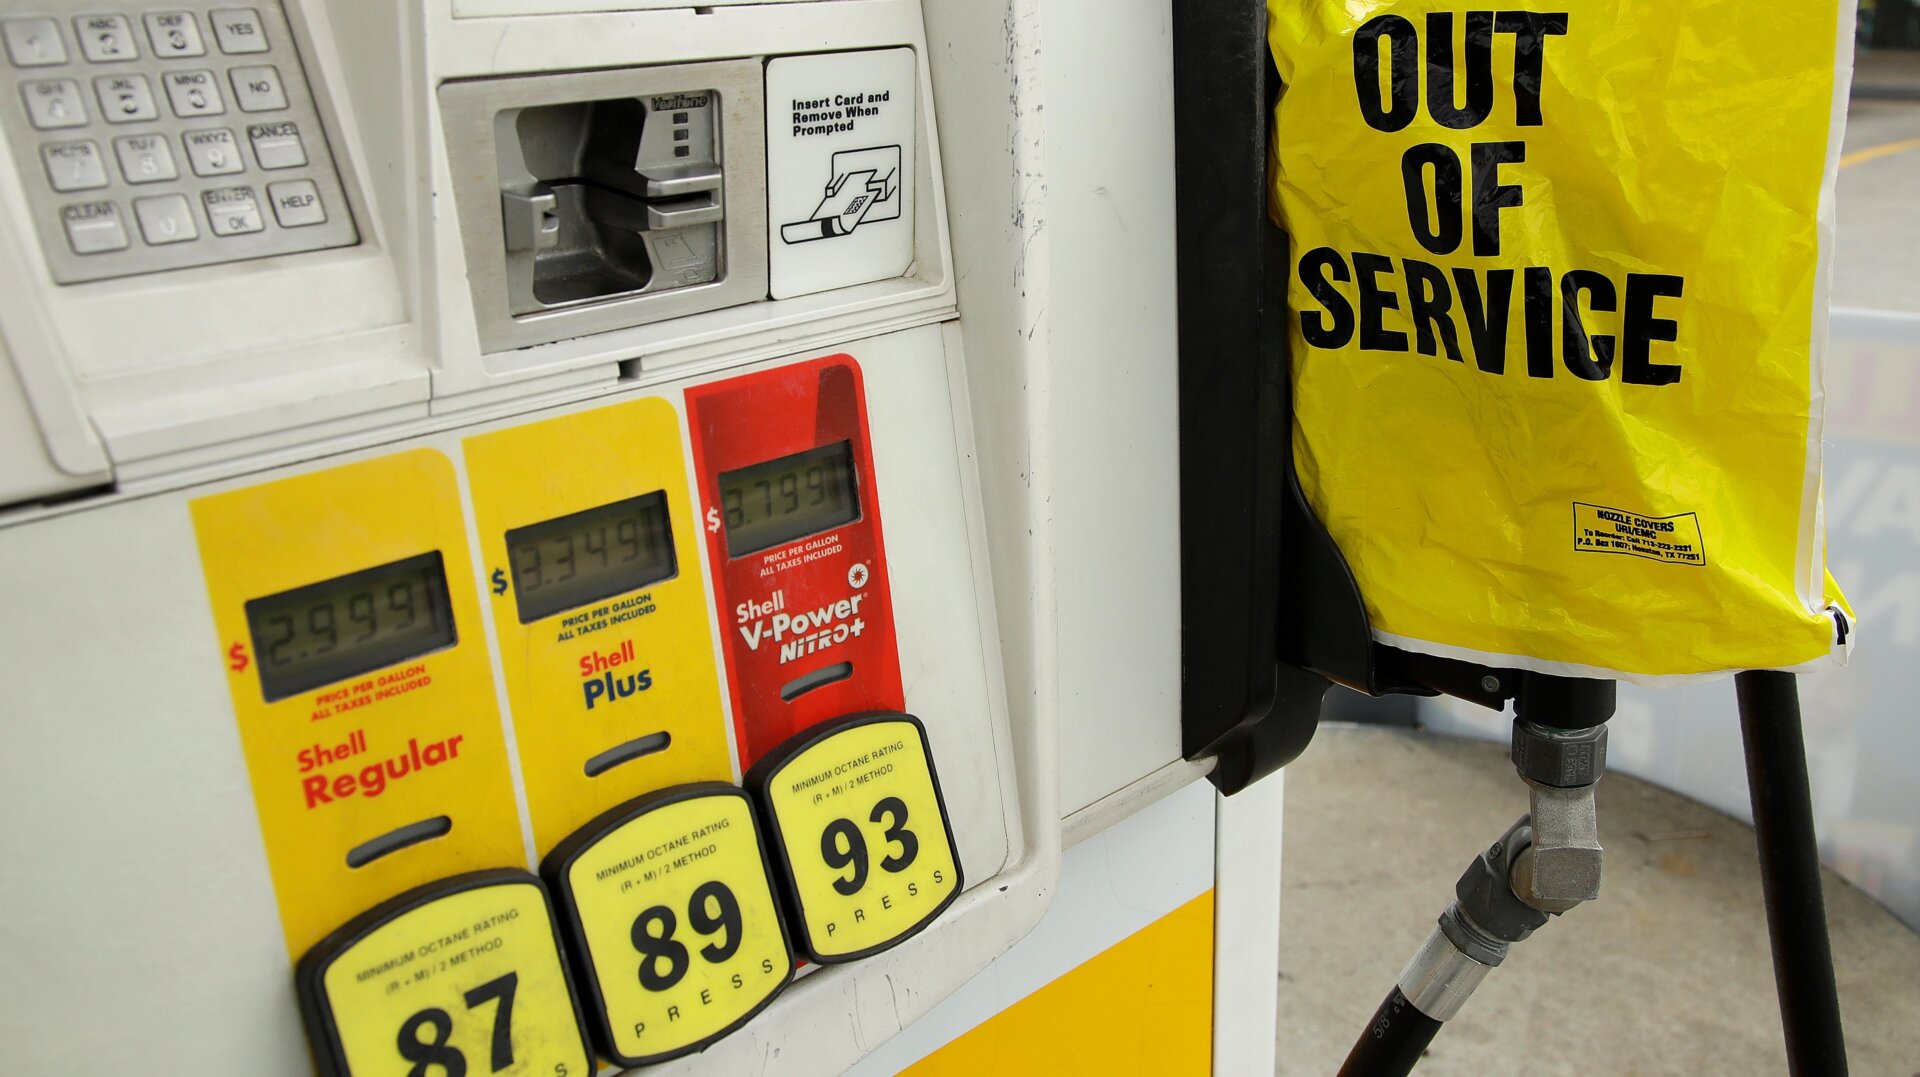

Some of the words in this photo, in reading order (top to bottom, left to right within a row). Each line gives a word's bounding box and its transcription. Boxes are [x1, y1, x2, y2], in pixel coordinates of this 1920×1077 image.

[100, 33, 118, 54] 2
[167, 30, 187, 49] 3
[225, 23, 254, 35] YES
[248, 81, 270, 94] NO
[1352, 11, 1568, 132] OUT
[792, 97, 830, 110] Insert
[835, 93, 863, 106] Card
[868, 90, 889, 103] and
[793, 110, 842, 123] Remove
[846, 106, 878, 118] When
[251, 124, 298, 139] CANCEL
[793, 120, 853, 136] Prompted
[207, 148, 226, 169] 9
[281, 195, 314, 209] HELP
[1401, 141, 1525, 256] OF
[228, 216, 248, 230] OK
[1298, 247, 1684, 386] SERVICE
[706, 506, 721, 533] $
[1584, 529, 1593, 537] To
[1626, 536, 1640, 544] Call
[1597, 510, 1632, 525] NOZZLE
[1634, 518, 1674, 532] COVERS
[764, 550, 787, 565] PRICE
[788, 545, 804, 556] PER
[805, 534, 839, 551] GALLON
[1577, 538, 1593, 546] P.O.
[1595, 539, 1609, 547] Box
[760, 566, 775, 578] ALL
[777, 557, 802, 572] TAXES
[804, 544, 842, 563] INCLUDED
[491, 568, 508, 596] $
[557, 631, 575, 643] ALL
[577, 620, 607, 636] TAXES
[610, 604, 657, 625] INCLUDED
[562, 613, 589, 629] PRICE
[592, 607, 609, 619] PER
[612, 594, 652, 613] GALLON
[736, 589, 785, 624] Shell
[739, 593, 863, 651] V-Power
[228, 641, 248, 673] $
[267, 580, 417, 668] 2.999
[579, 639, 635, 677] Shell
[310, 708, 332, 722] ALL
[335, 695, 372, 714] TAXES
[375, 676, 432, 701] INCLUDED
[315, 688, 349, 706] PRICE
[353, 681, 374, 695] PER
[378, 664, 425, 688] GALLON
[583, 668, 652, 710] Plus
[297, 729, 367, 774] Shell
[791, 769, 832, 794] MINIMUM
[835, 754, 871, 776] OCTANE
[872, 740, 904, 760] RATING
[302, 734, 464, 810] Regular
[812, 793, 823, 805] (R
[831, 784, 843, 796] M)
[856, 763, 894, 785] METHOD
[596, 854, 644, 881] MINIMUM
[647, 835, 689, 860] OCTANE
[692, 818, 730, 840] RATING
[820, 796, 919, 897] 93
[620, 880, 632, 894] (R
[643, 870, 657, 882] M)
[673, 843, 717, 869] METHOD
[355, 951, 415, 984] MINIMUM
[418, 928, 470, 958] OCTANE
[473, 908, 520, 935] RATING
[449, 936, 503, 967] METHOD
[630, 880, 743, 992] 89
[396, 970, 519, 1077] 87
